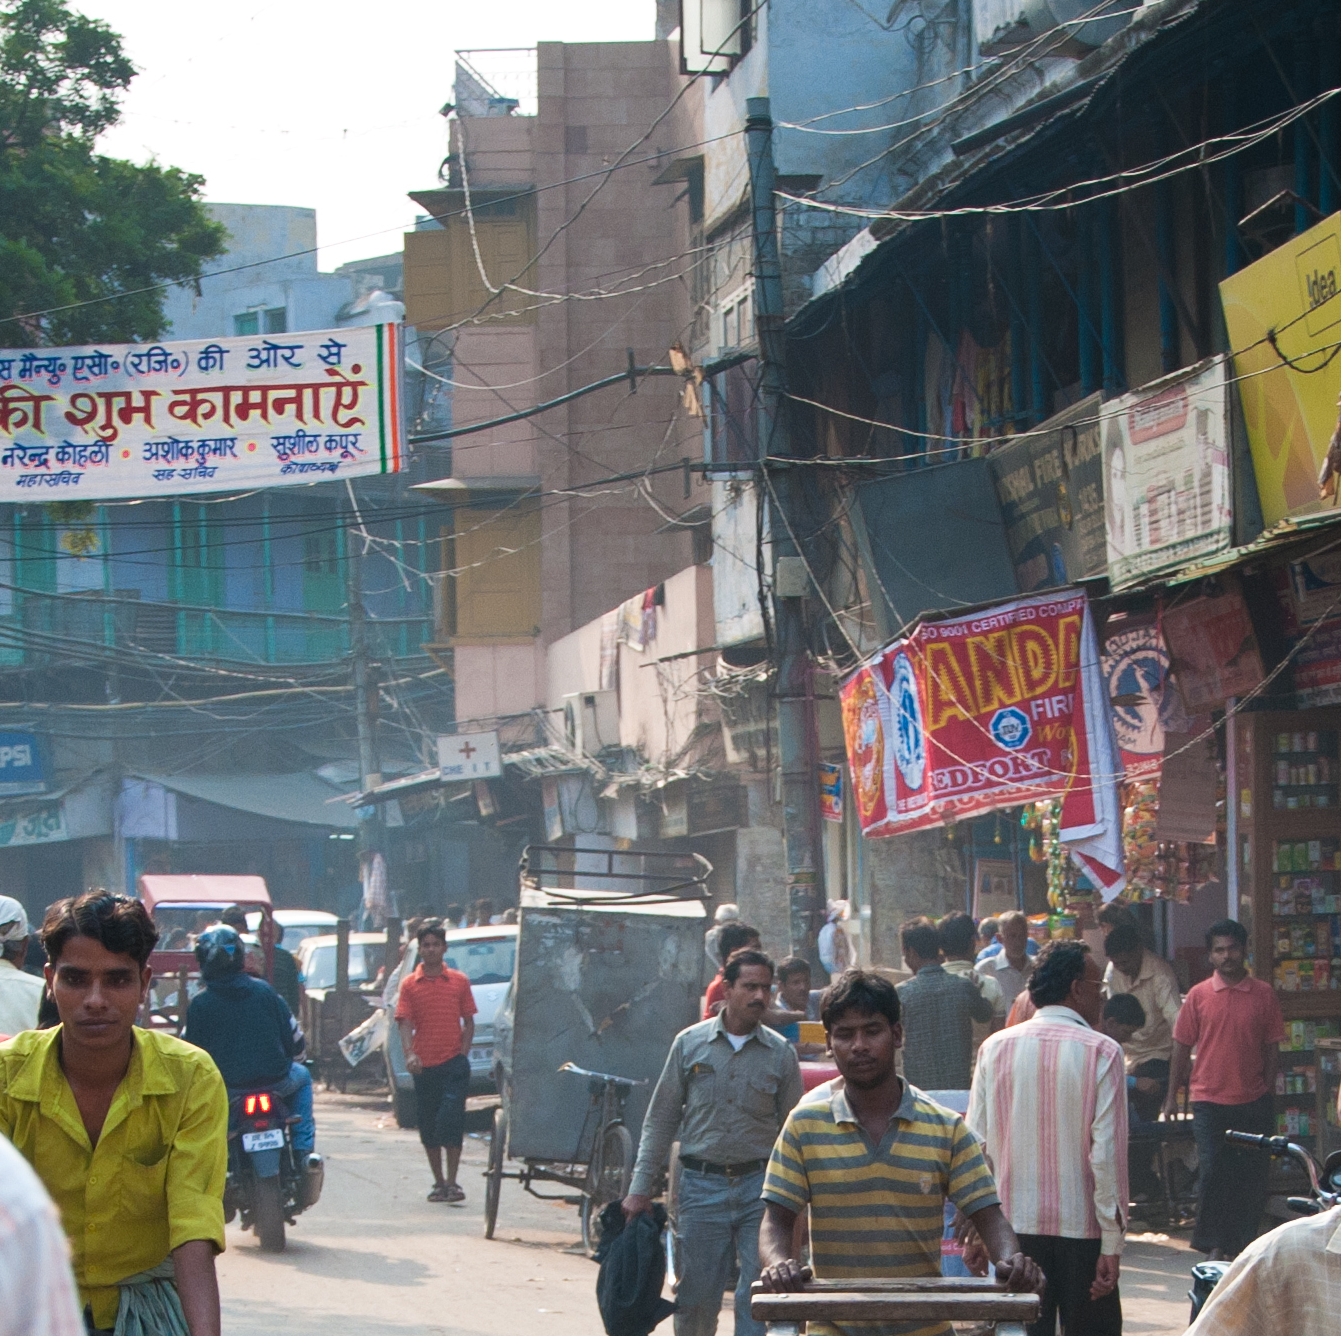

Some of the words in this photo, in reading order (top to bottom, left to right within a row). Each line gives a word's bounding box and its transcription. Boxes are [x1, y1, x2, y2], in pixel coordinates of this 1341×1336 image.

[196, 343, 230, 371] की
[245, 340, 305, 370] ओर
[316, 337, 347, 366] से
[63, 388, 162, 443] शुभ
[939, 624, 969, 640] 9001
[971, 606, 1037, 634] CERTIFIED
[930, 748, 1052, 796] EDFORT
